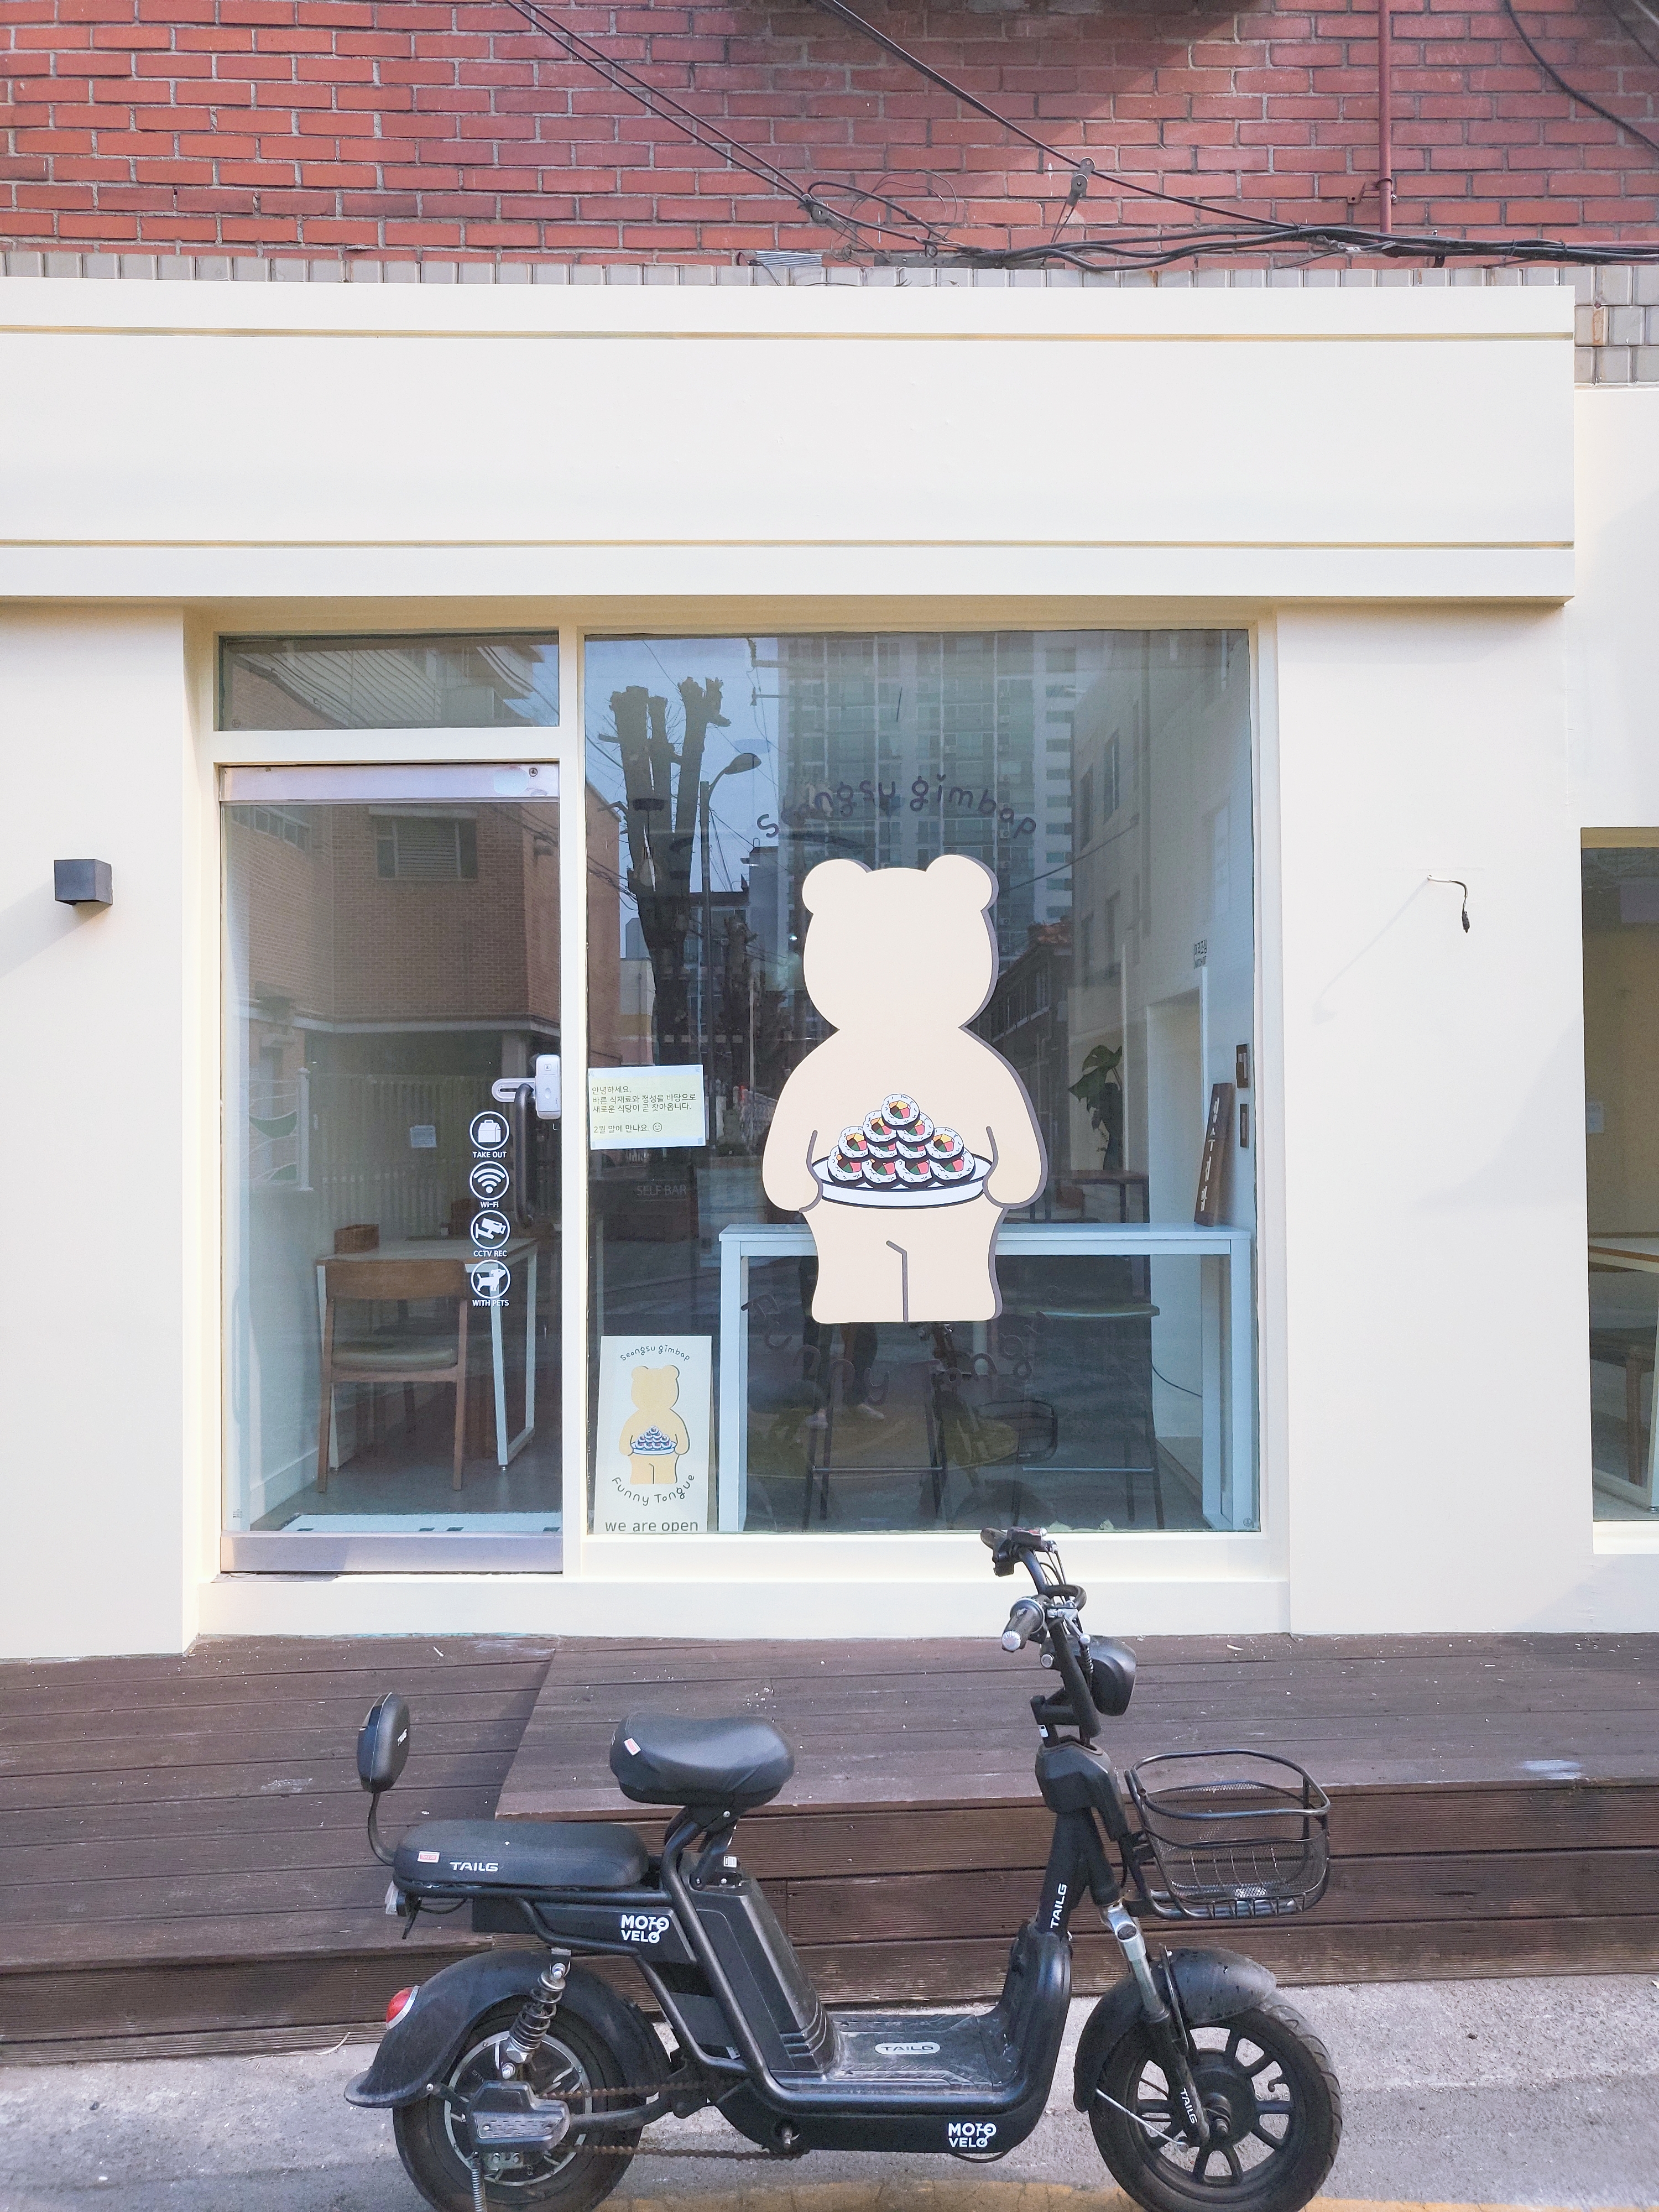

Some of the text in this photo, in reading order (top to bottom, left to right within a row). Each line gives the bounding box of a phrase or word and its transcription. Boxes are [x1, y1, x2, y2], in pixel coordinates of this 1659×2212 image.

[909, 773, 1037, 839] gimbap
[592, 1086, 632, 1095] 안녕하세요.
[592, 1093, 697, 1105] 바른 식재료와 정성을 바탕으로
[592, 1102, 692, 1114] 새로운 식당이 곧 찾아옵니다.
[593, 1124, 650, 1134] 2월 말에 만나요.
[665, 1184, 687, 1196] BAR
[620, 1344, 690, 1361] Seongsu gimbap
[612, 1474, 695, 1506] Funny Tongue
[605, 1521, 698, 1532] we are open
[449, 1861, 499, 1872] TAILG
[1050, 1882, 1067, 1929] TAILG
[620, 1929, 660, 1944] VELO
[1180, 2087, 1198, 2124] TAILG
[948, 2137, 988, 2148] VELO
